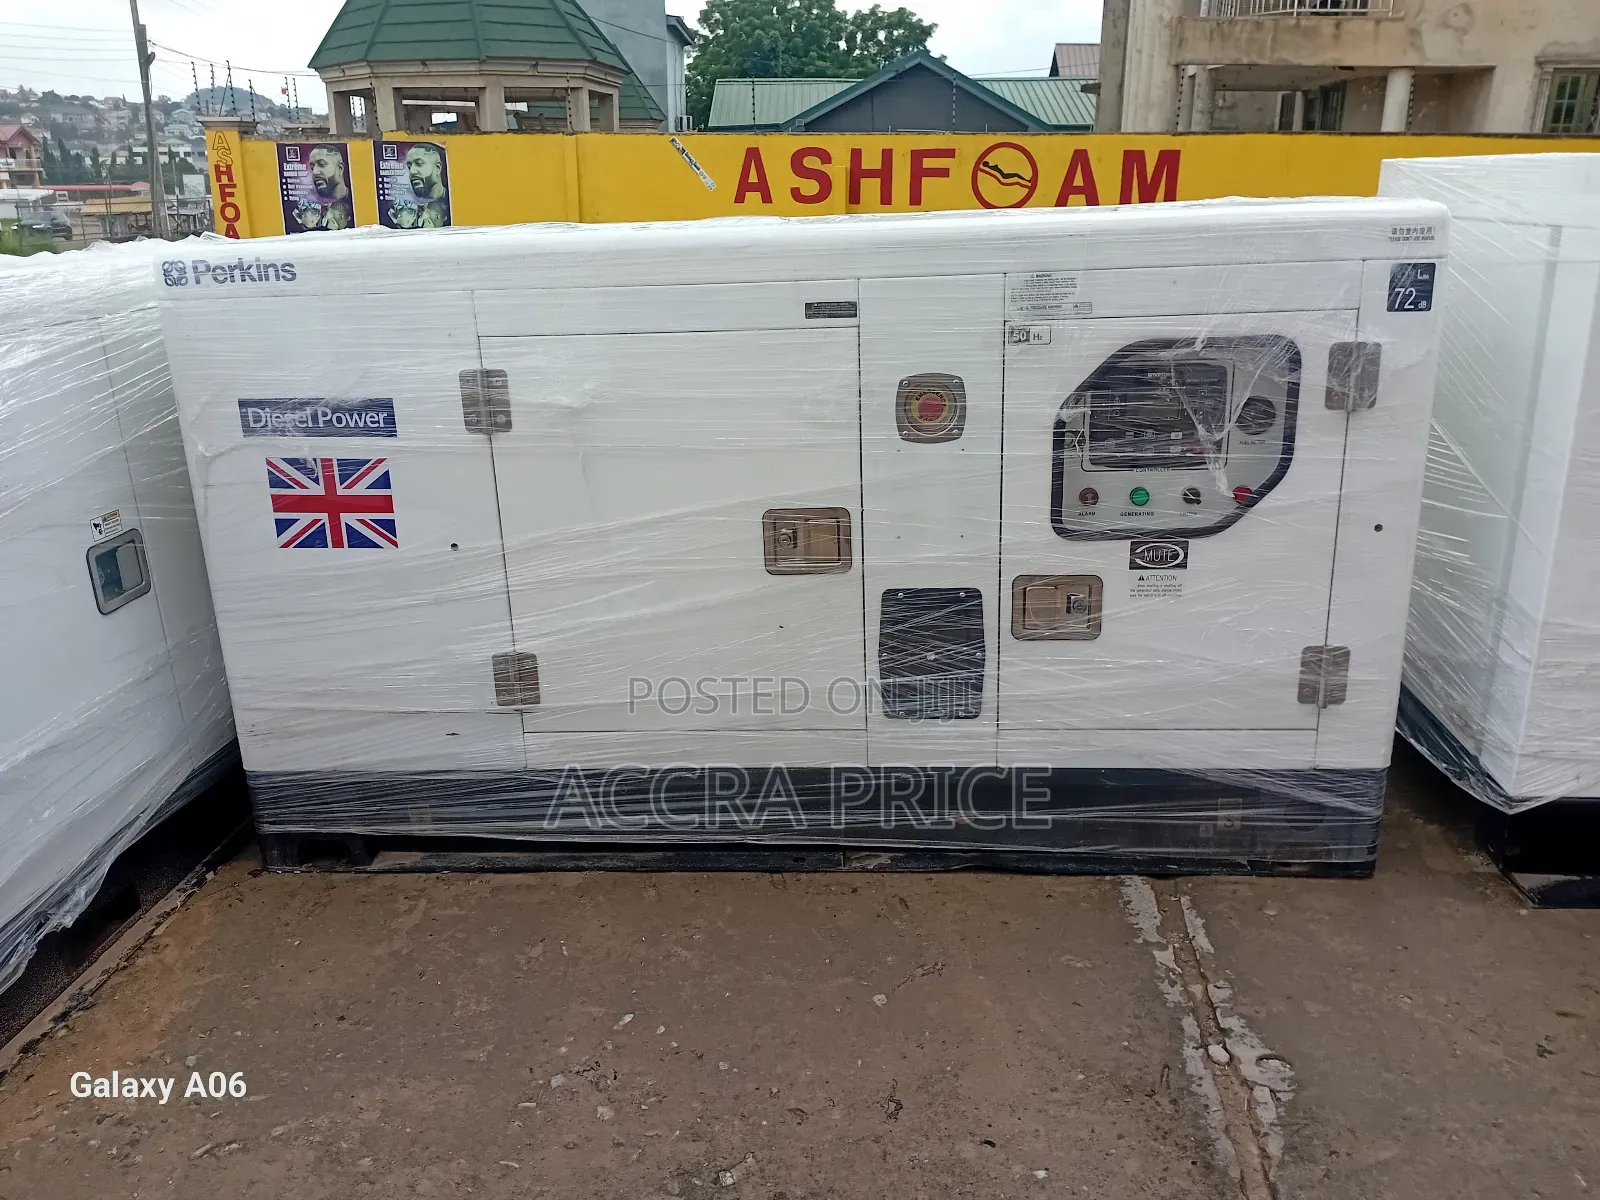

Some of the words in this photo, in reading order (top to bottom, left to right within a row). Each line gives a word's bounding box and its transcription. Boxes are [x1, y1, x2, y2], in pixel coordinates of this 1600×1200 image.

[283, 162, 307, 171] Extreme
[379, 161, 404, 170] Extreme
[192, 256, 297, 285] Perkins
[1394, 287, 1416, 309] 72
[1417, 300, 1427, 309] dB
[246, 406, 313, 428] Diesel
[317, 406, 388, 428] Power
[1144, 549, 1175, 561] MUTE
